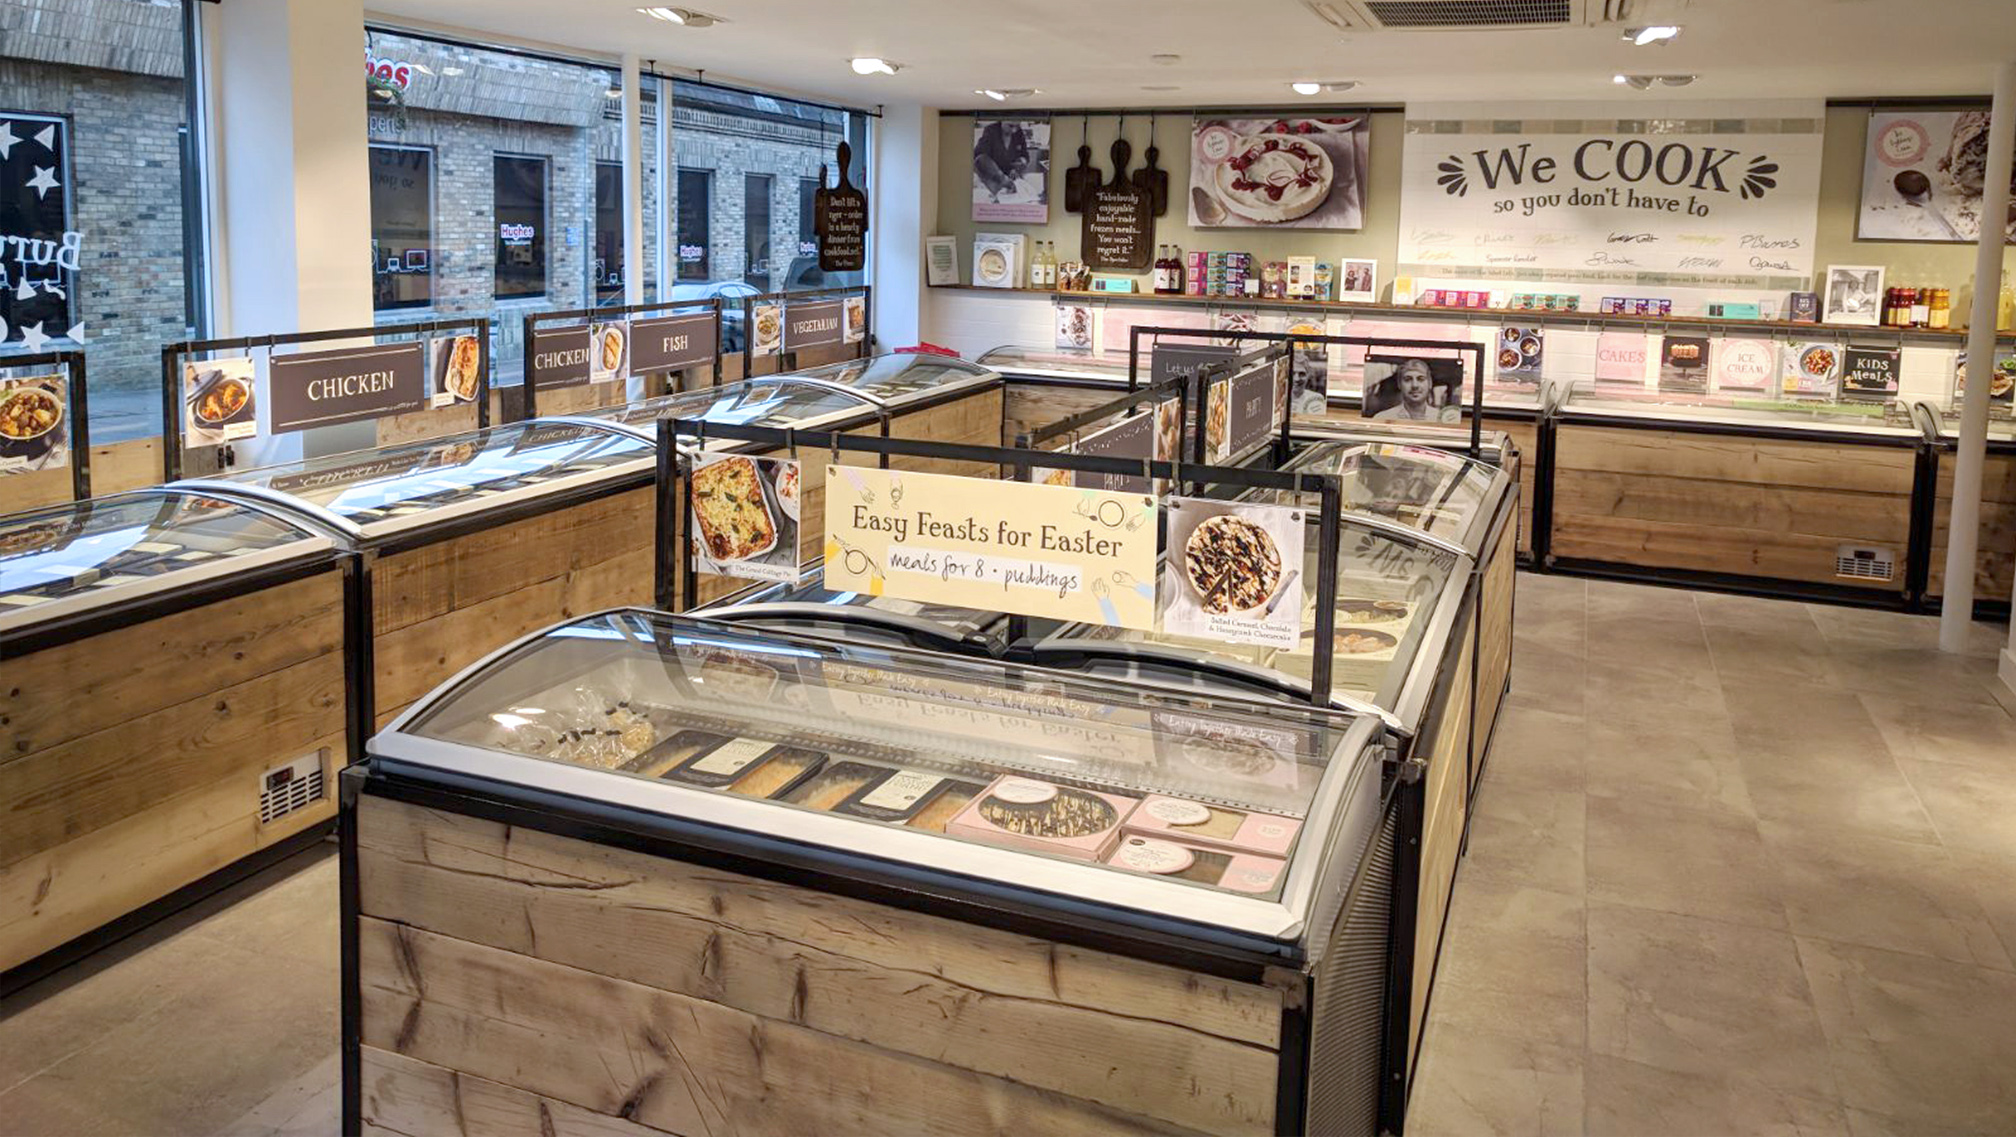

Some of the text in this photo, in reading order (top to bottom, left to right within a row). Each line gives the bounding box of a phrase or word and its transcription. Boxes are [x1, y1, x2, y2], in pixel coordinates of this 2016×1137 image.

[1472, 139, 1740, 193] We COOK
[1494, 187, 1709, 218] so you don't have to
[501, 224, 534, 241] Hughes
[793, 317, 839, 335] VEGETARIAN
[663, 335, 689, 352] FISH
[534, 348, 590, 370] CHICKEN
[1599, 349, 1646, 363] CAKES
[1737, 353, 1755, 362] ICE
[1726, 363, 1764, 374] CREAM
[308, 370, 396, 400] CHICKEN
[852, 505, 1123, 558] Easy Feasts for Easter
[890, 552, 1079, 599] meals for 8 puddings
[1211, 617, 1230, 625] Salted
[1260, 623, 1291, 633] Chocolate
[1254, 630, 1291, 641] Cheesecake
[1169, 715, 1197, 735] Eating
[1259, 728, 1281, 748] Easy
